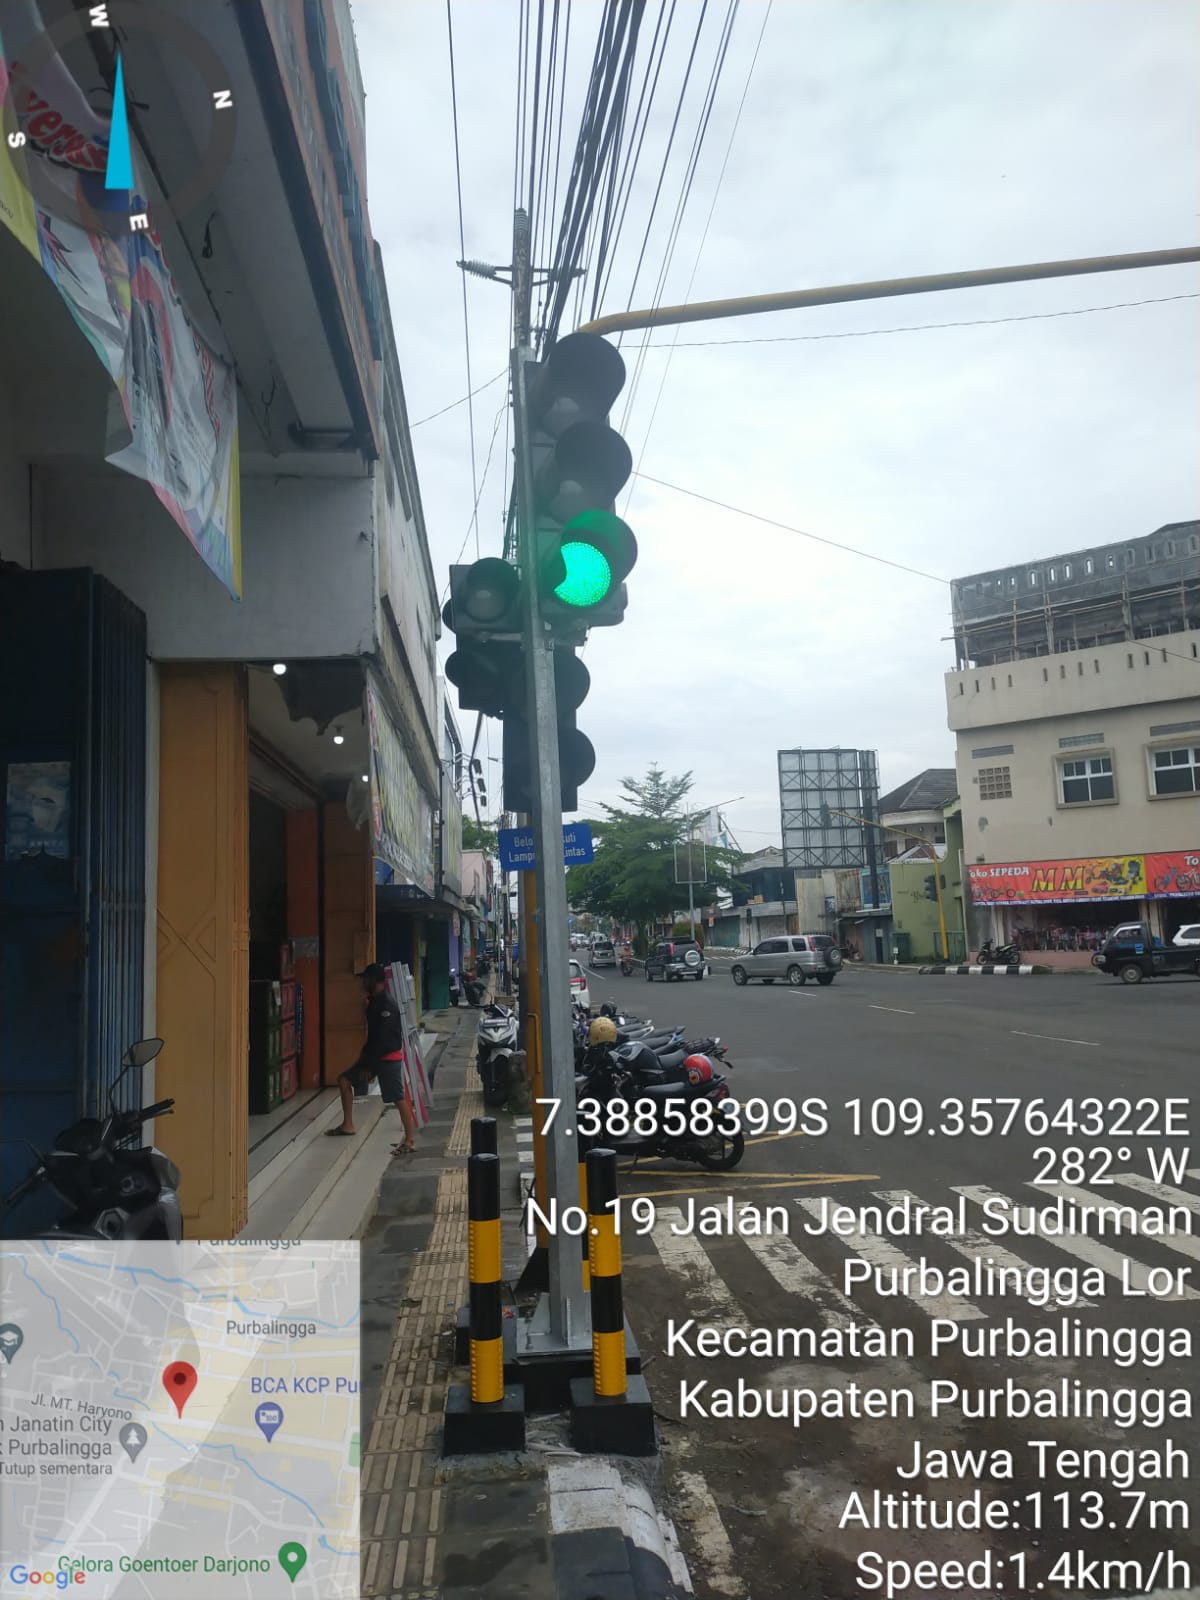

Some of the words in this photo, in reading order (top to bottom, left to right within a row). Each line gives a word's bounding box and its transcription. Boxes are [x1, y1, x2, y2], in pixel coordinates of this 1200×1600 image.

[513, 836, 534, 848] Belo
[1184, 855, 1200, 866] To
[969, 868, 988, 878] oko
[989, 866, 1030, 877] SEPEDA
